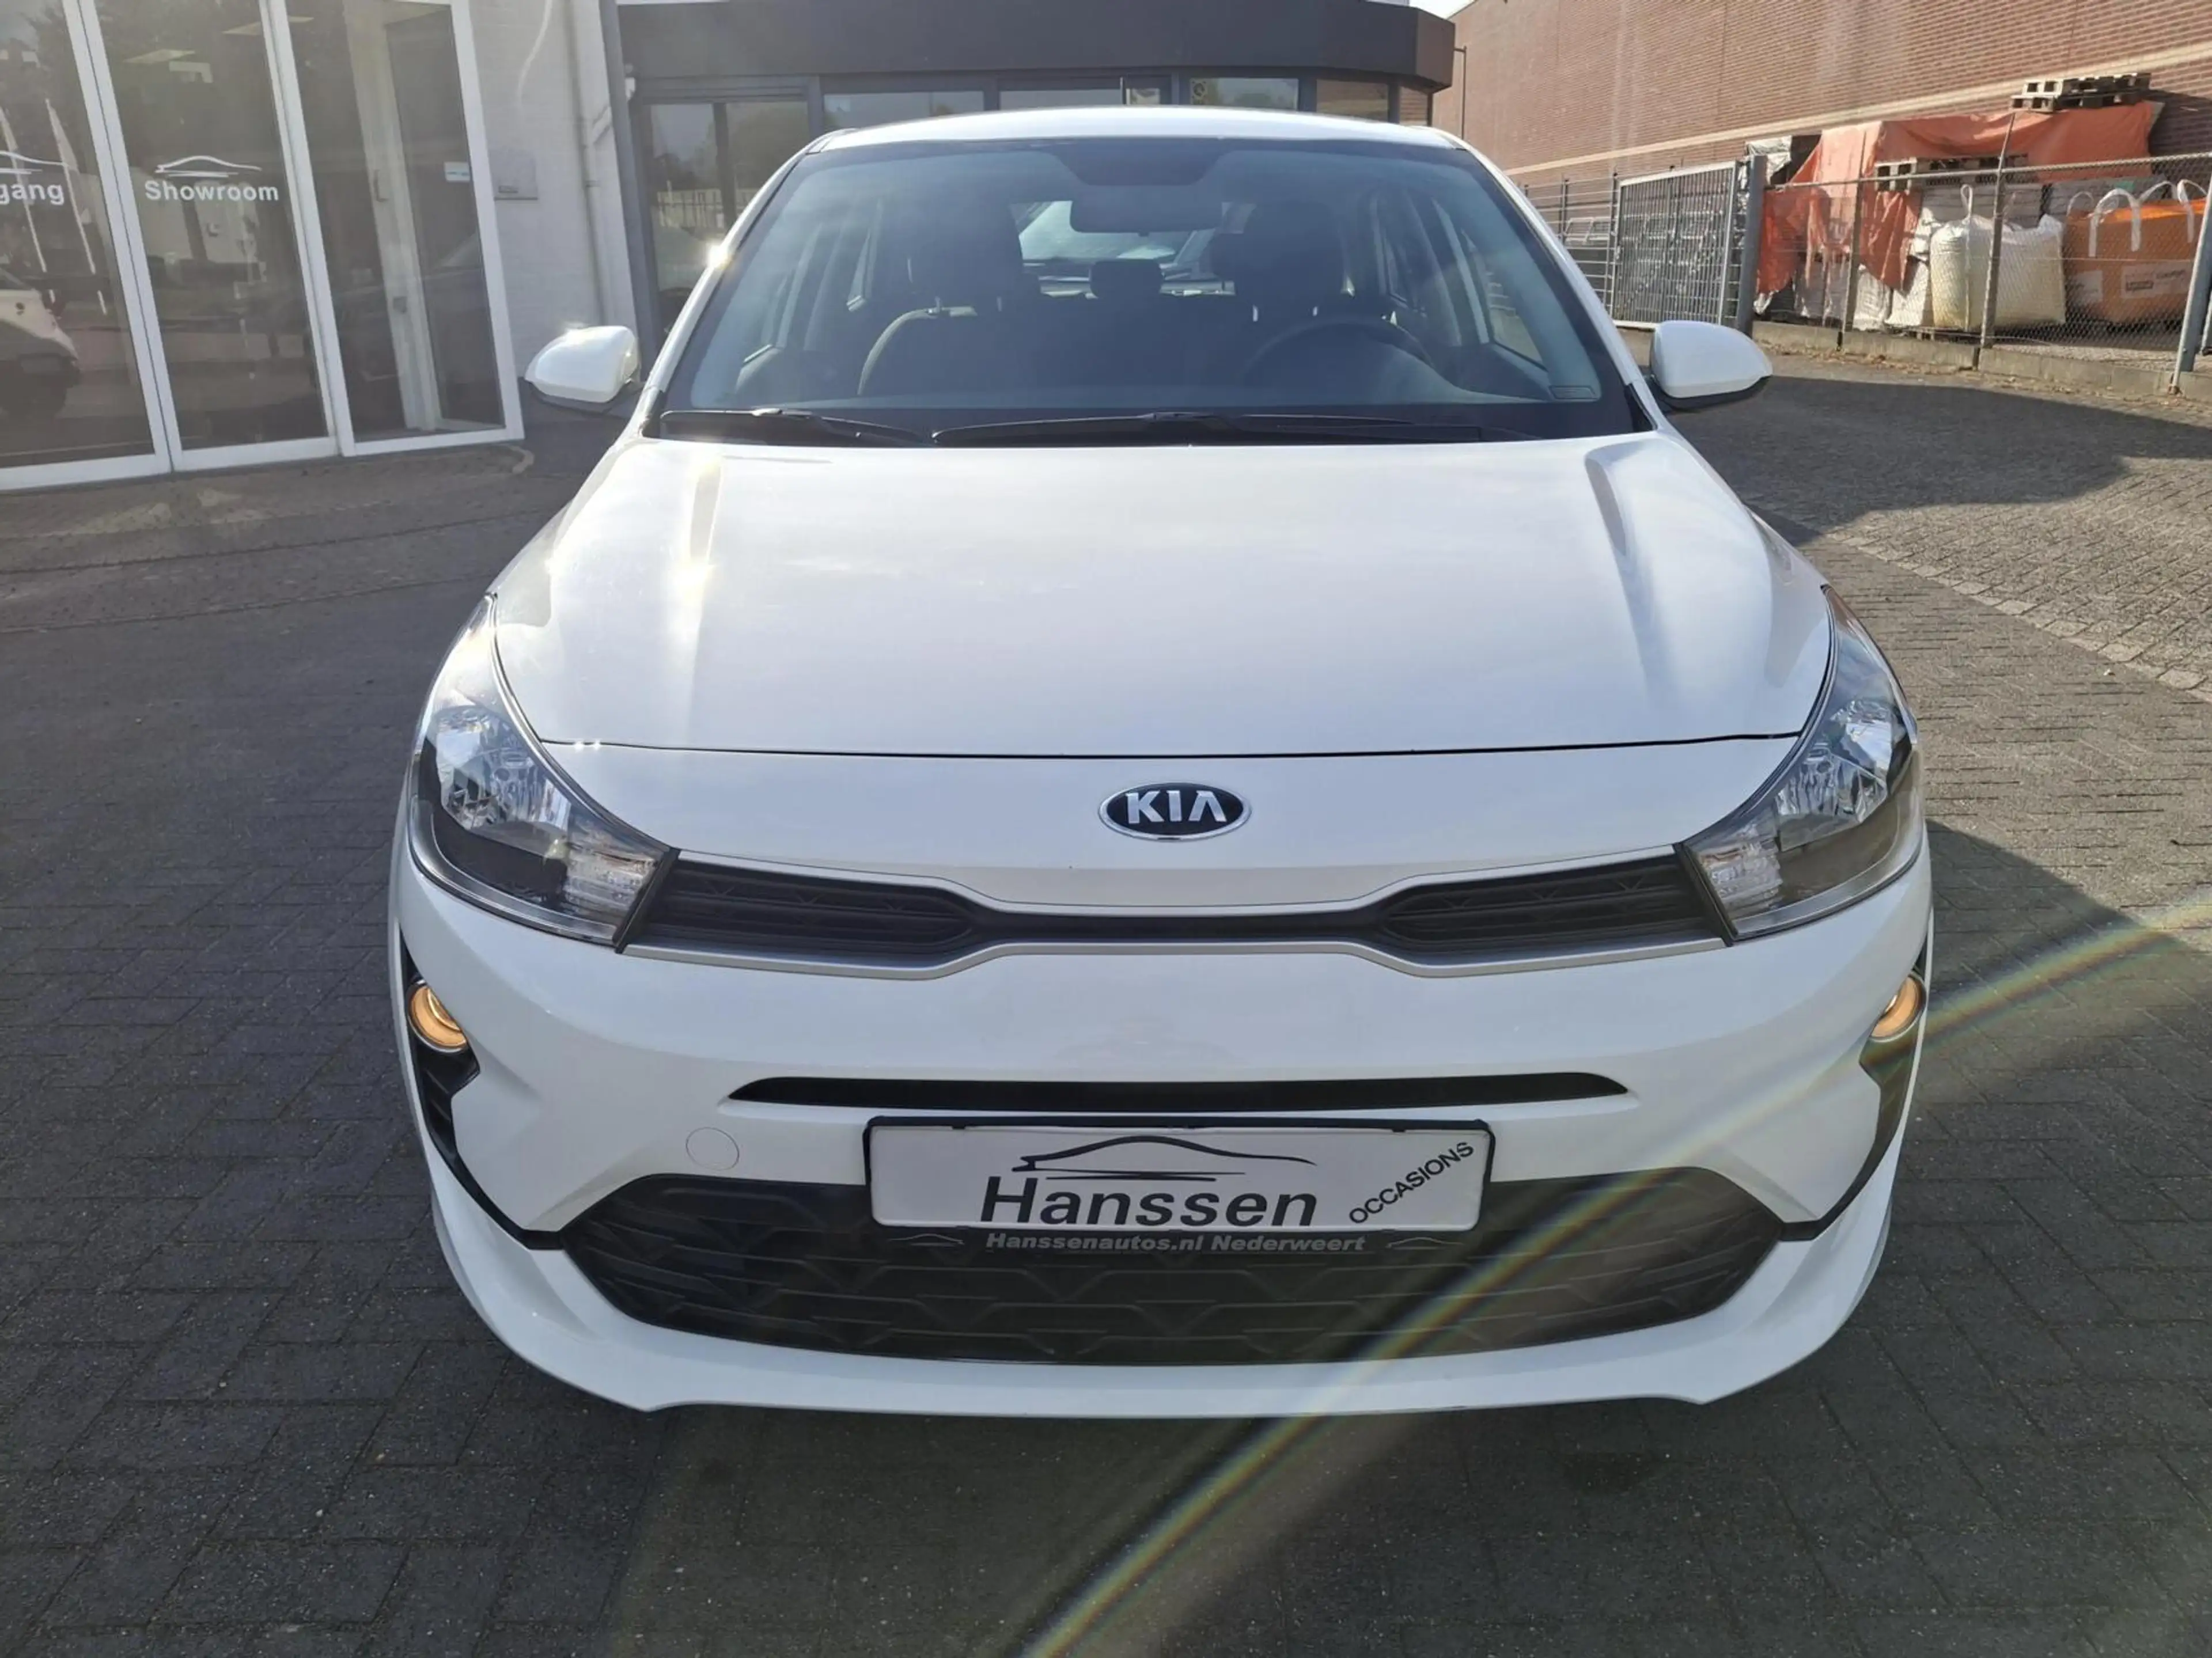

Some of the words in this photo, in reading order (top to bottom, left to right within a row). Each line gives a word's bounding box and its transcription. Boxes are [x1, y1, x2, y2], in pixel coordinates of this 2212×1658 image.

[145, 180, 279, 200] Showroom
[1125, 790, 1227, 824] KIA
[1349, 1142, 1474, 1223] OCCASIONS
[980, 1176, 1317, 1227] Hanssen
[986, 1232, 1202, 1252] Hanssenautos.nl
[1211, 1234, 1366, 1252] Nederweert
